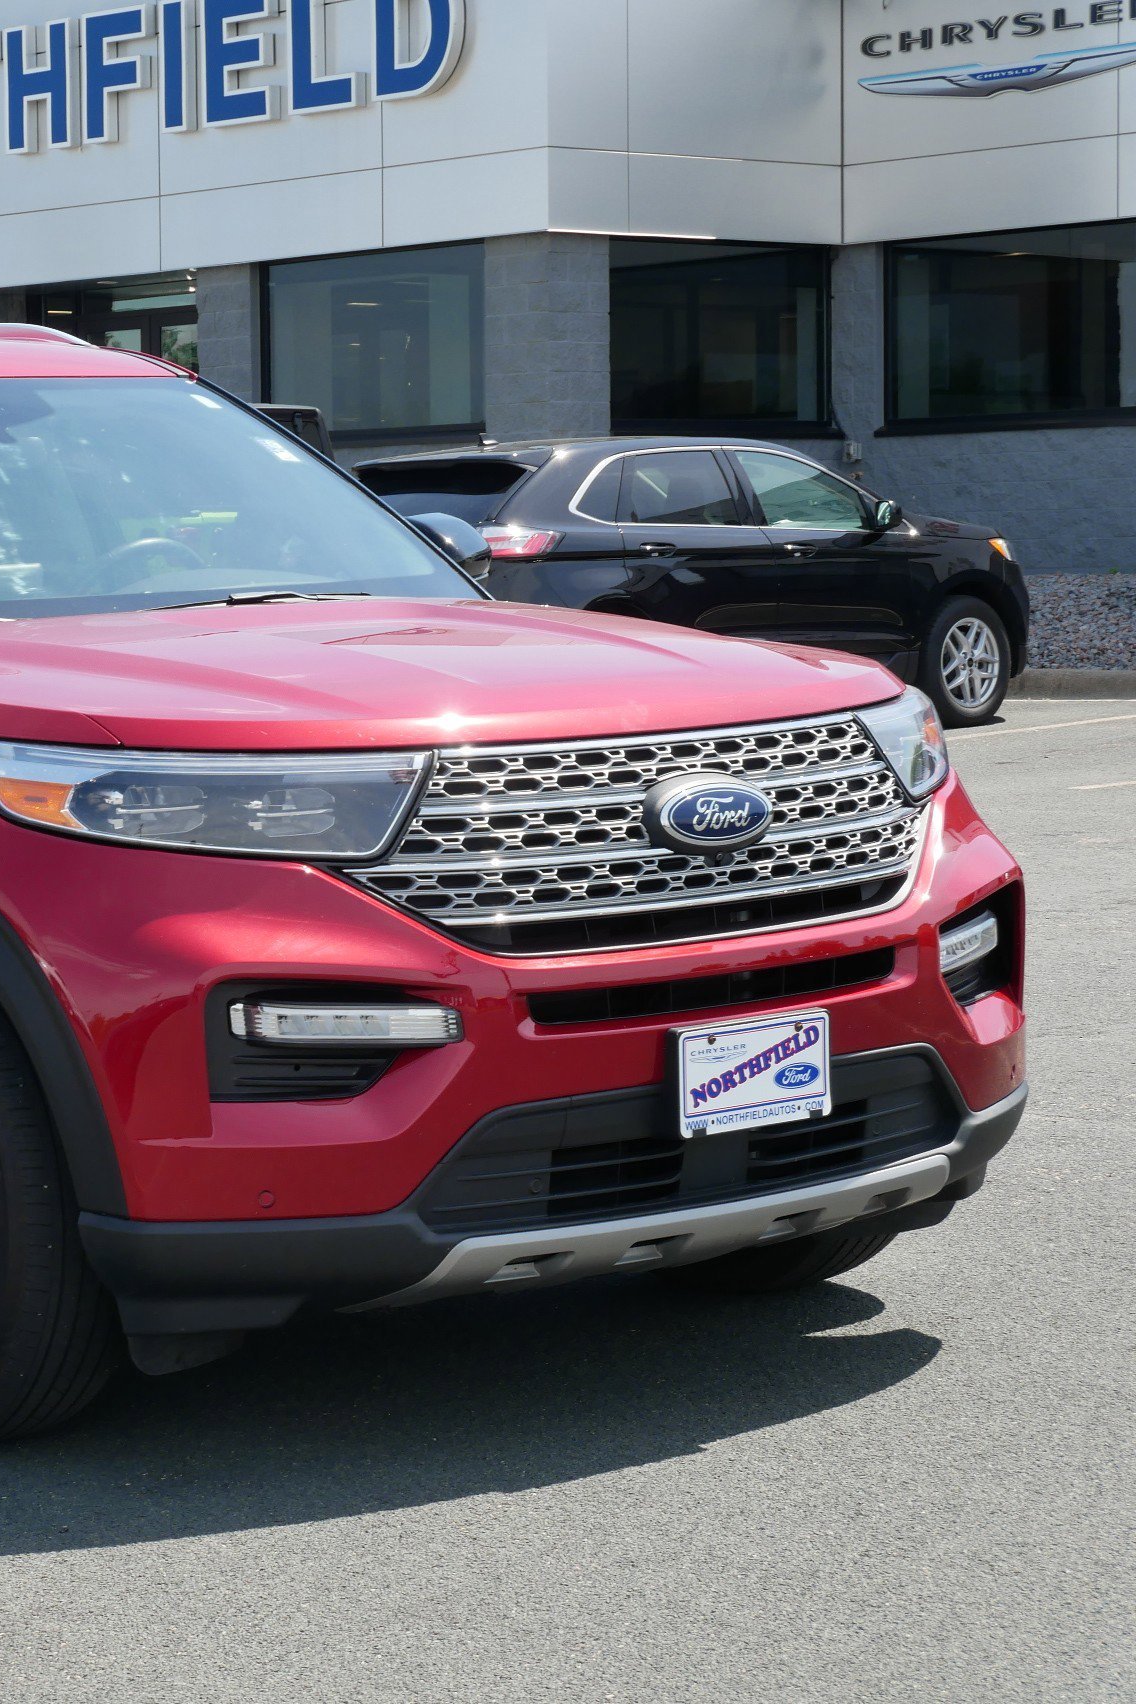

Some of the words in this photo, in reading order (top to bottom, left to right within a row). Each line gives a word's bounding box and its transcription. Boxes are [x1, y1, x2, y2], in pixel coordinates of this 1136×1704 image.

[860, 0, 1136, 58] CHRYSLE
[976, 67, 1037, 80] CHRYSLER
[692, 796, 751, 832] Ford
[690, 1043, 746, 1056] CHRYSLER
[690, 1025, 819, 1108] NORTHFIELD
[782, 1067, 810, 1084] Ford
[716, 1104, 796, 1125] NORTHFIELDAUTOS
